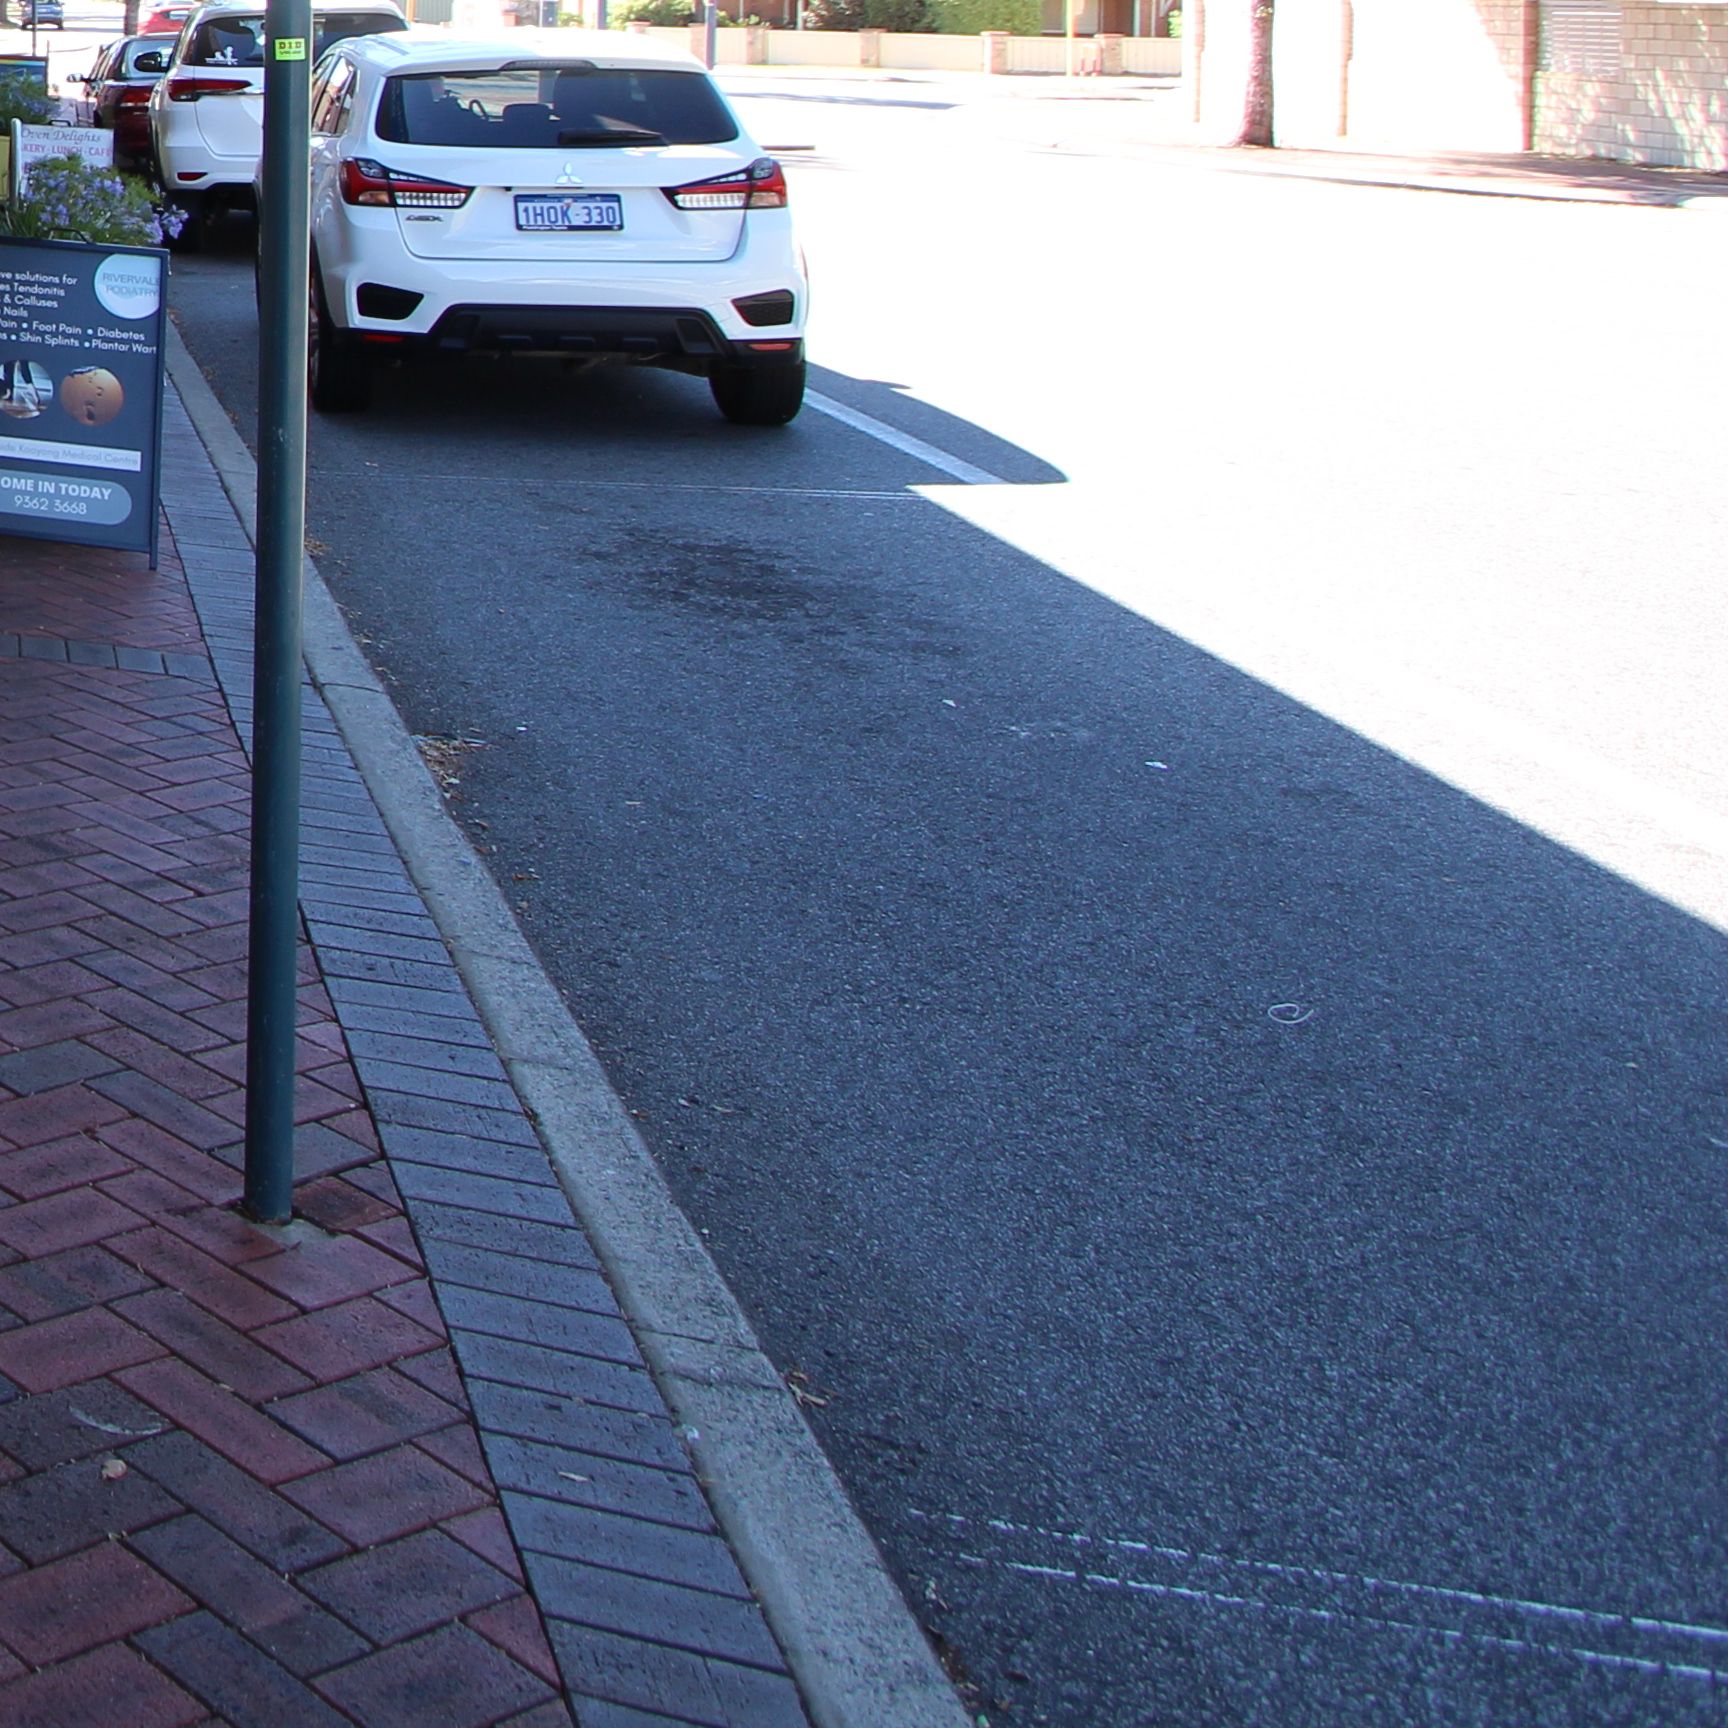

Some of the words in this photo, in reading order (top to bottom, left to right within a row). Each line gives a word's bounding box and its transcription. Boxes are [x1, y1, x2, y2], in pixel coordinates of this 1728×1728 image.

[52, 130, 101, 145] Delights
[21, 143, 46, 154] KERY
[15, 271, 59, 284] solutions
[62, 274, 78, 285] for
[14, 283, 65, 296] Tendonitis
[4, 294, 11, 303] &
[15, 295, 58, 308] Calluses
[4, 306, 28, 317] Nails
[33, 321, 56, 332] Foot
[59, 323, 82, 335] Pain
[98, 327, 145, 341] Diabetes
[19, 332, 42, 343] Shin
[45, 334, 80, 347] Splints
[92, 339, 130, 352] Plantar
[38, 480, 55, 494] IN
[59, 483, 112, 500] TODAY
[14, 495, 48, 511] 9362
[54, 499, 87, 515] 3668
